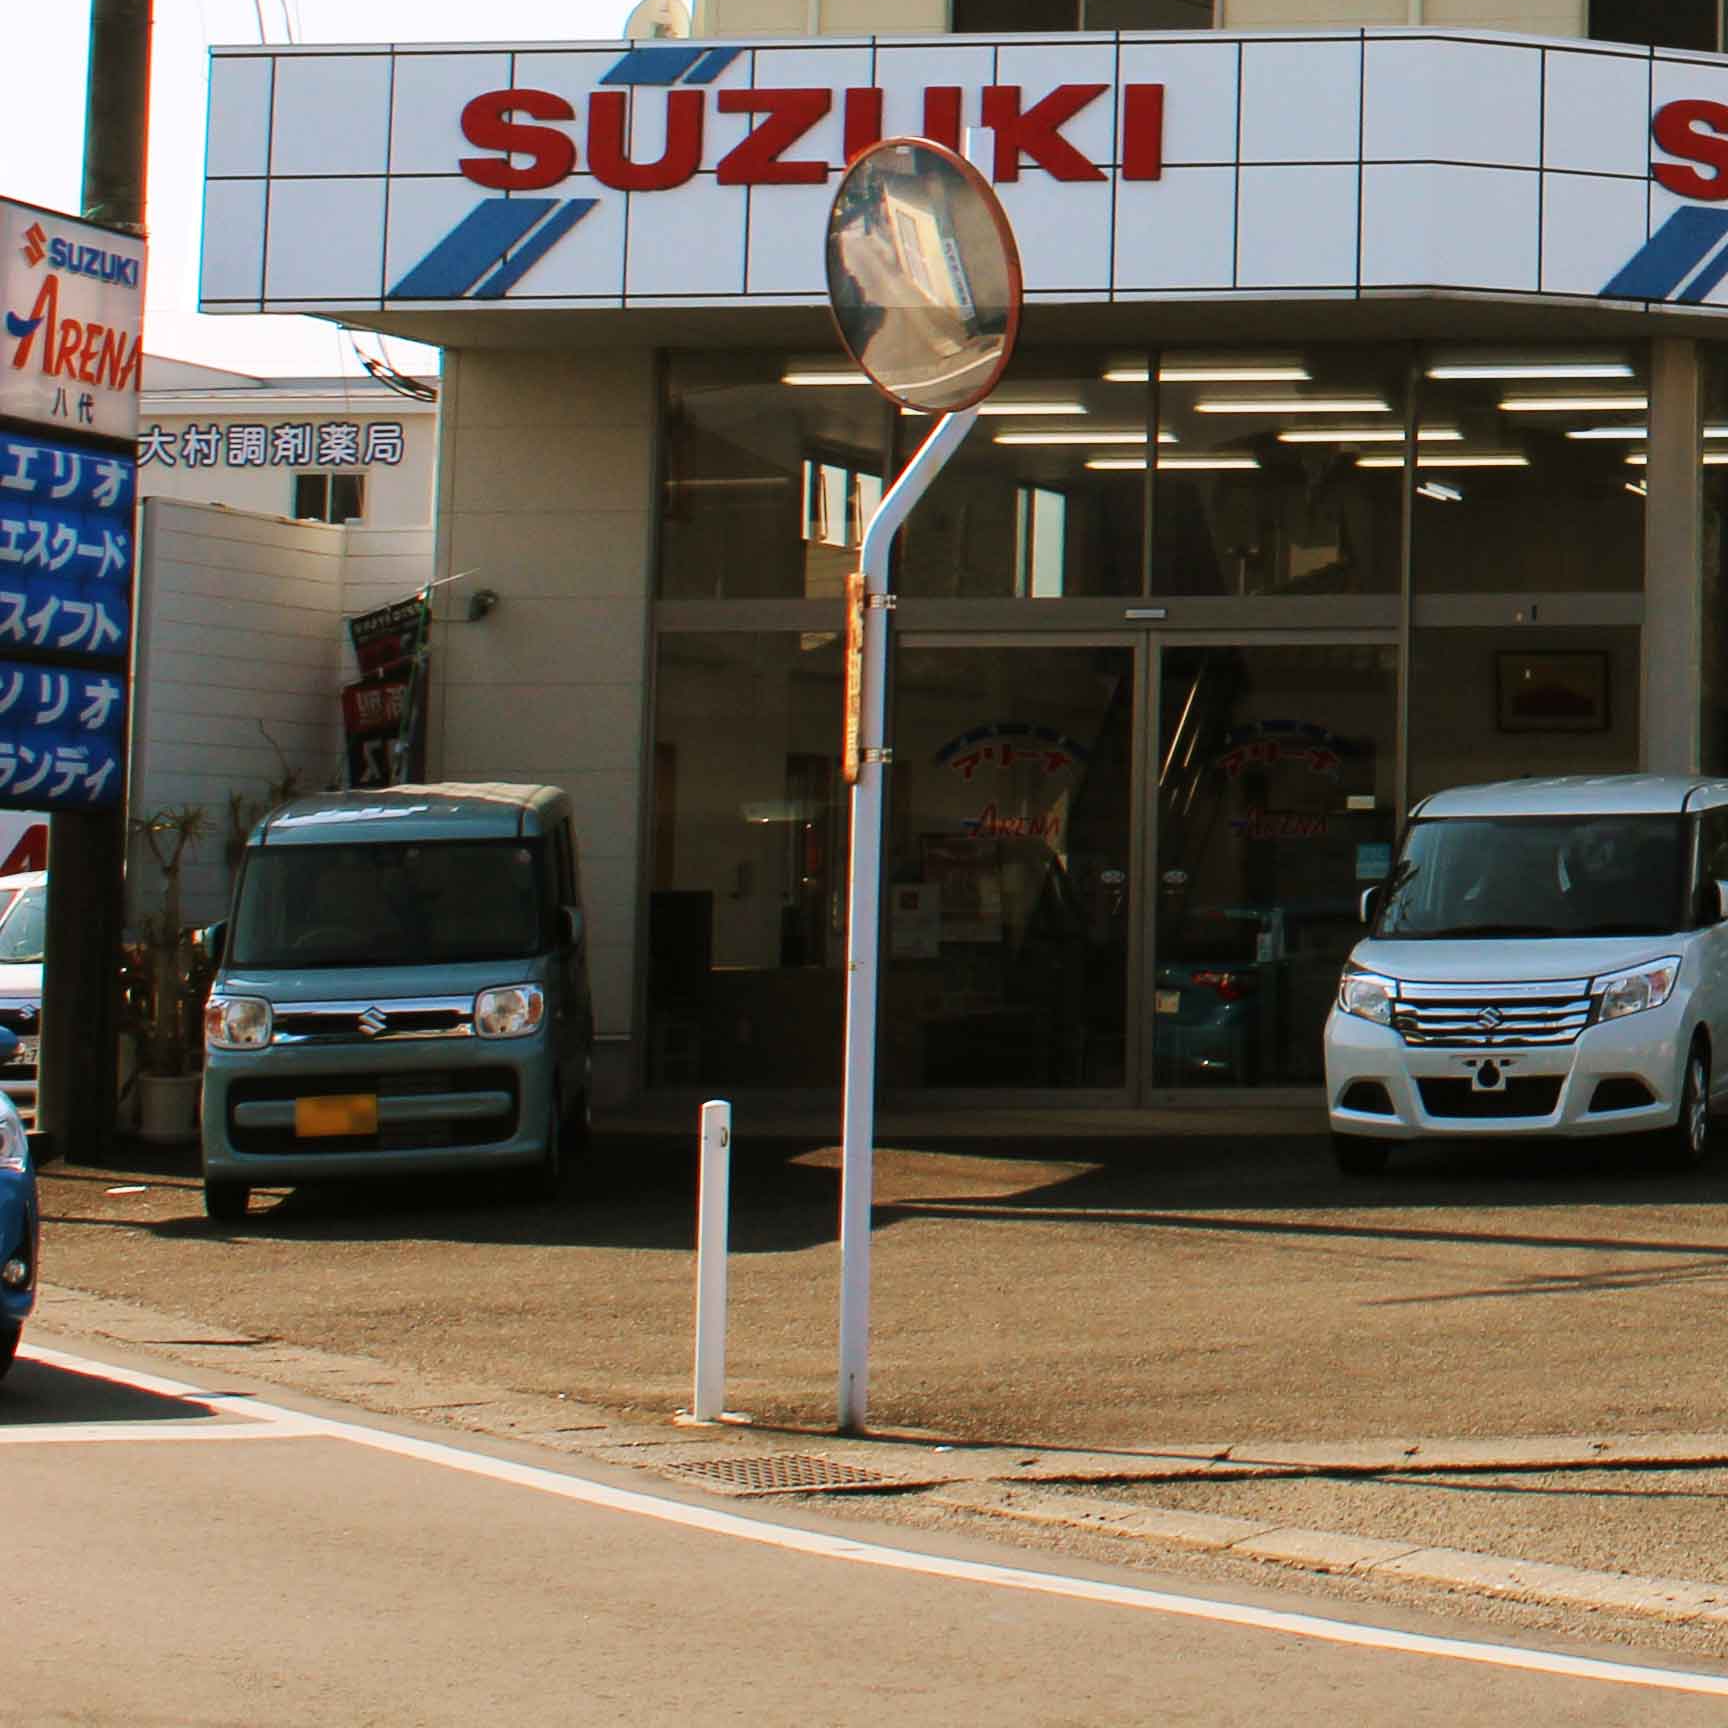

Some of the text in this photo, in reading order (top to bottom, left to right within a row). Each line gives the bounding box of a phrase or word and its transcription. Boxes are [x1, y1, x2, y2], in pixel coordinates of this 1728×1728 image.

[459, 84, 1164, 191] SUZUKI
[48, 236, 139, 289] SUZUKI
[6, 274, 142, 392] ARENA
[138, 422, 404, 467] 大村調剤薬局
[1, 443, 128, 508] エリオ
[0, 519, 127, 577] エスクード
[0, 591, 121, 651] スイフト
